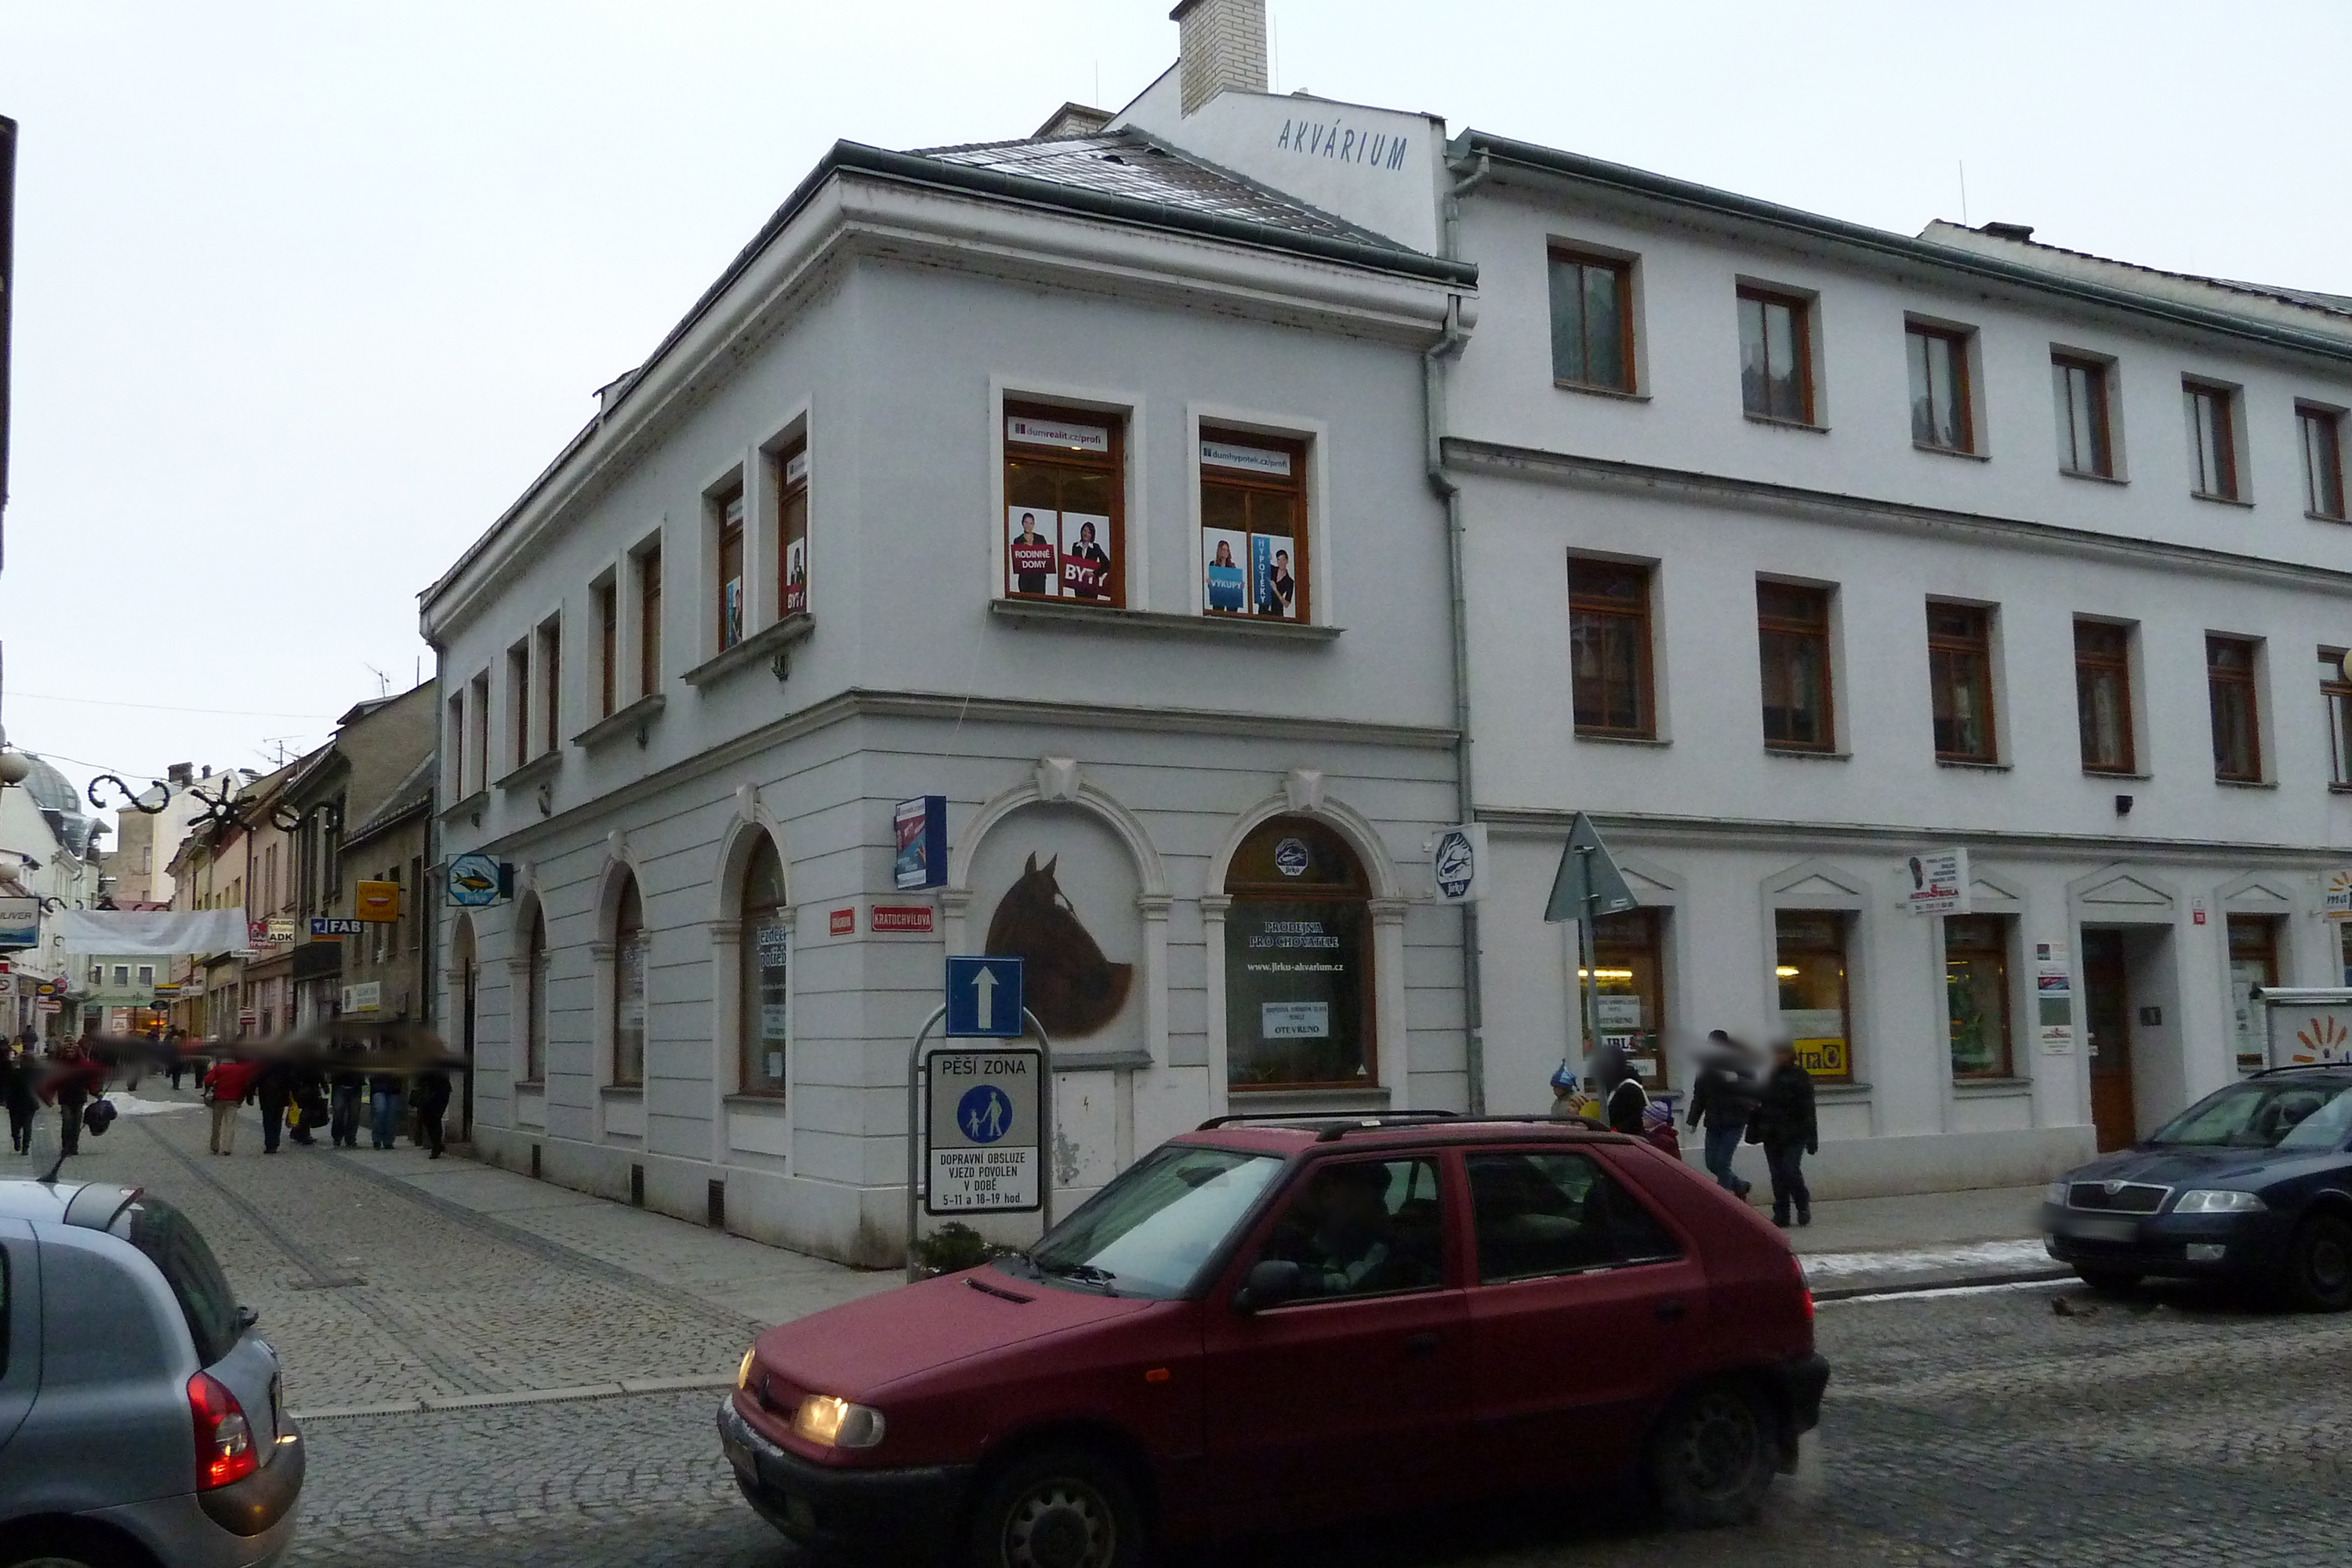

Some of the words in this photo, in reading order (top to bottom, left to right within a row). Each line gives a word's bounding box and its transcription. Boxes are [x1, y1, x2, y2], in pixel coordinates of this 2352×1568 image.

[1277, 118, 1407, 171] AKVÁRIUM
[1026, 426, 1102, 445] dumrealit.cz/profi
[1212, 450, 1287, 469] dumhypotek.cz/profi
[1014, 549, 1051, 559] RODINNÉ
[1021, 560, 1047, 569] DOMY
[1258, 538, 1267, 604] HYPOTEKY
[1065, 563, 1109, 587] BYTY
[330, 920, 362, 933] FAB
[874, 912, 931, 927] KRATOCHVÍLOVA
[1265, 921, 1324, 935] PRODEJNA
[1249, 936, 1274, 948] PRO
[1276, 936, 1340, 948] CHOVATELE
[1247, 962, 1344, 973] www.jirku-akvarium.cz
[942, 1056, 978, 1075] PĚŠÍ
[984, 1056, 1026, 1075] ZÓNA
[941, 1151, 984, 1165] DOPRAVNÍ
[988, 1152, 1025, 1163] OBSLUZE
[949, 1167, 975, 1178] VJEZD
[978, 1166, 1018, 1178] POVOLEN
[964, 1180, 971, 1192] V
[975, 1178, 996, 1191] DOBĚ
[943, 1194, 963, 1206] 5-11
[976, 1192, 1000, 1204] 18-19
